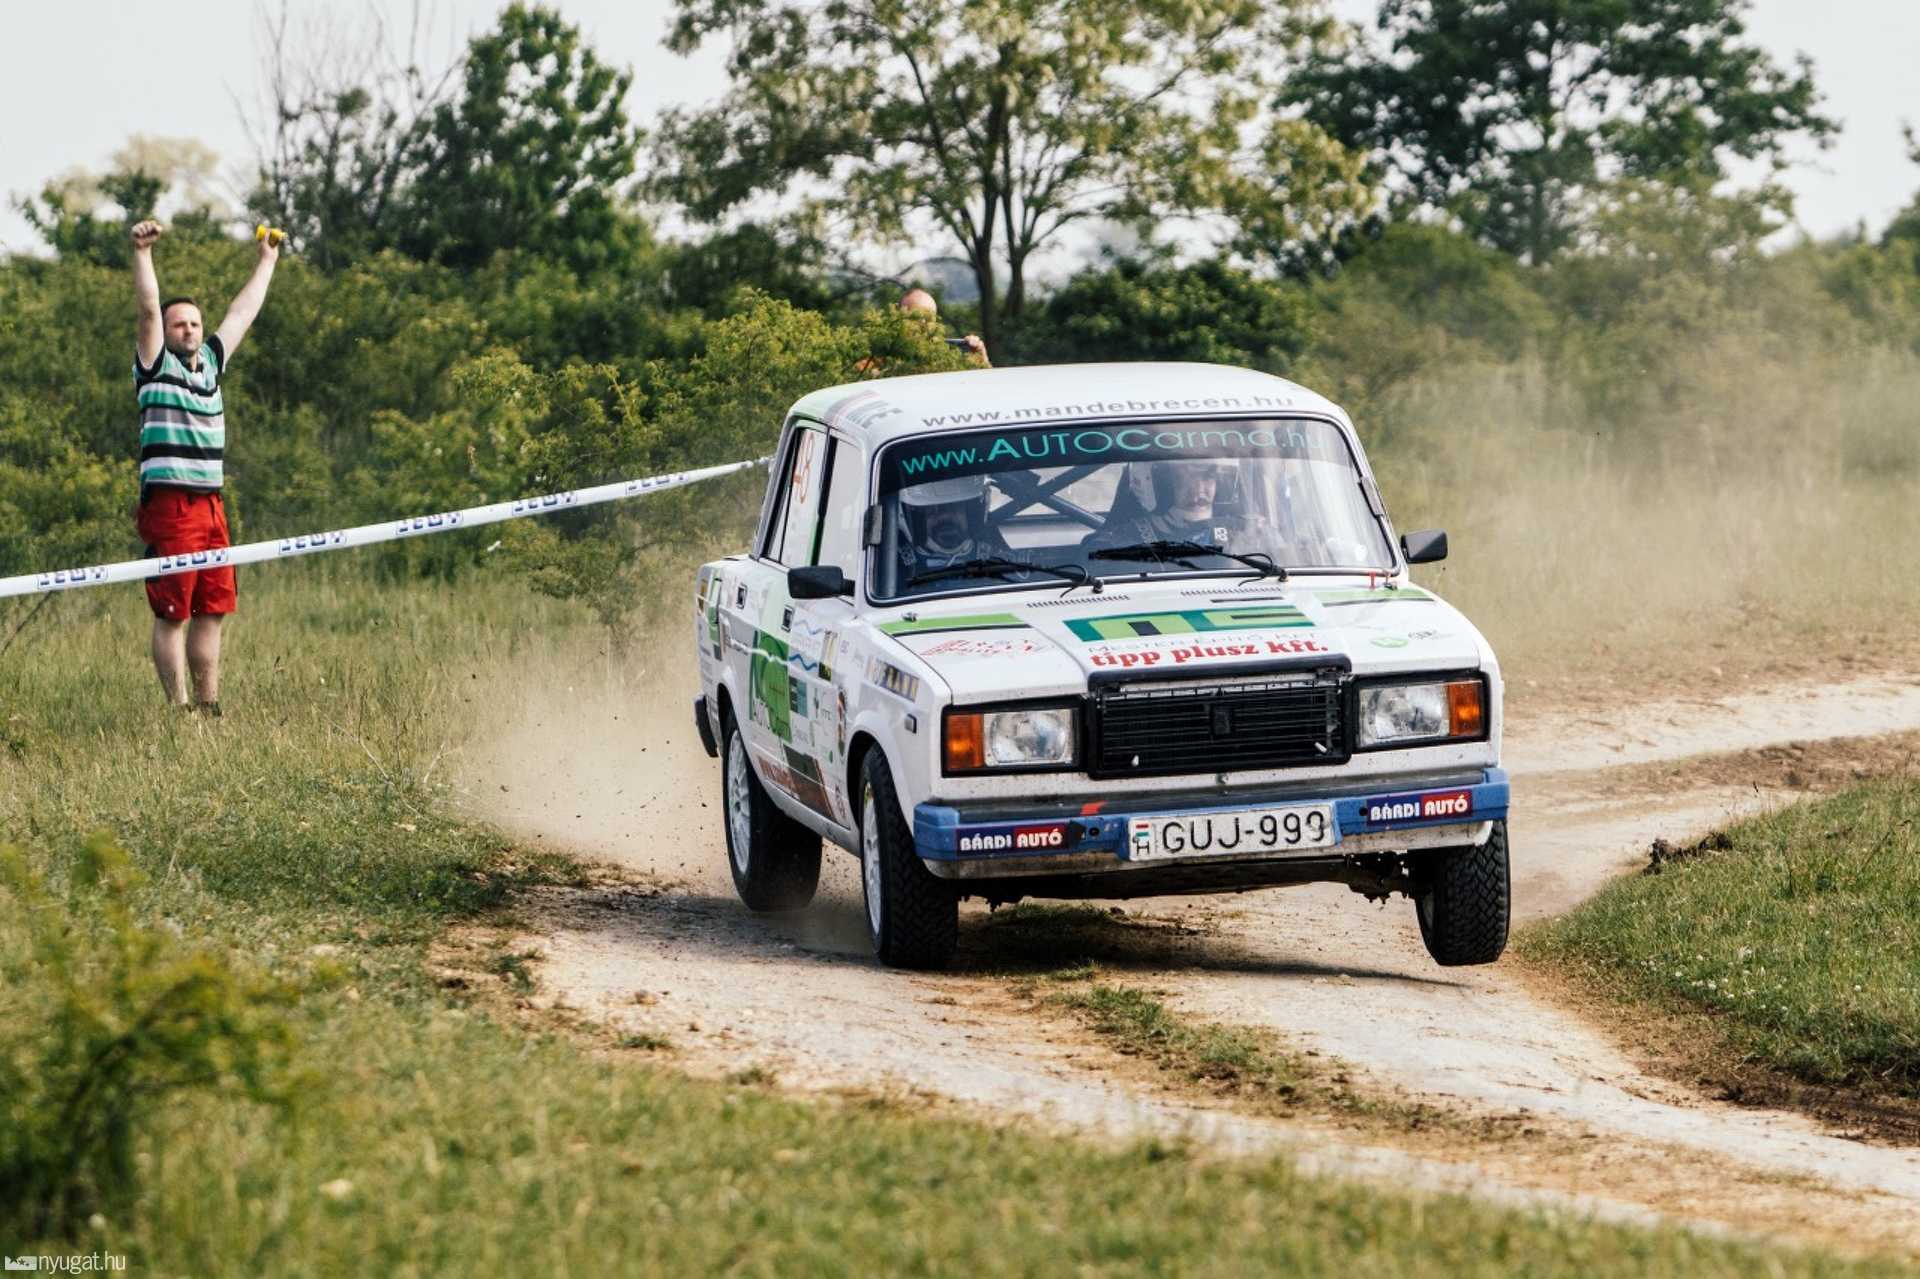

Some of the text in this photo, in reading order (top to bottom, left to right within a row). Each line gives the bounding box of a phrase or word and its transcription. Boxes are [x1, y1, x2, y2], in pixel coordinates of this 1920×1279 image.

[922, 396, 1294, 427] www.mandebrecen.hu
[1090, 639, 1328, 667] tipp plusz kft.
[1370, 794, 1468, 821] BÁRDI AUTÓ
[960, 828, 1062, 851] BÁRDI AUTÓ
[1162, 811, 1325, 853] GUJ-999
